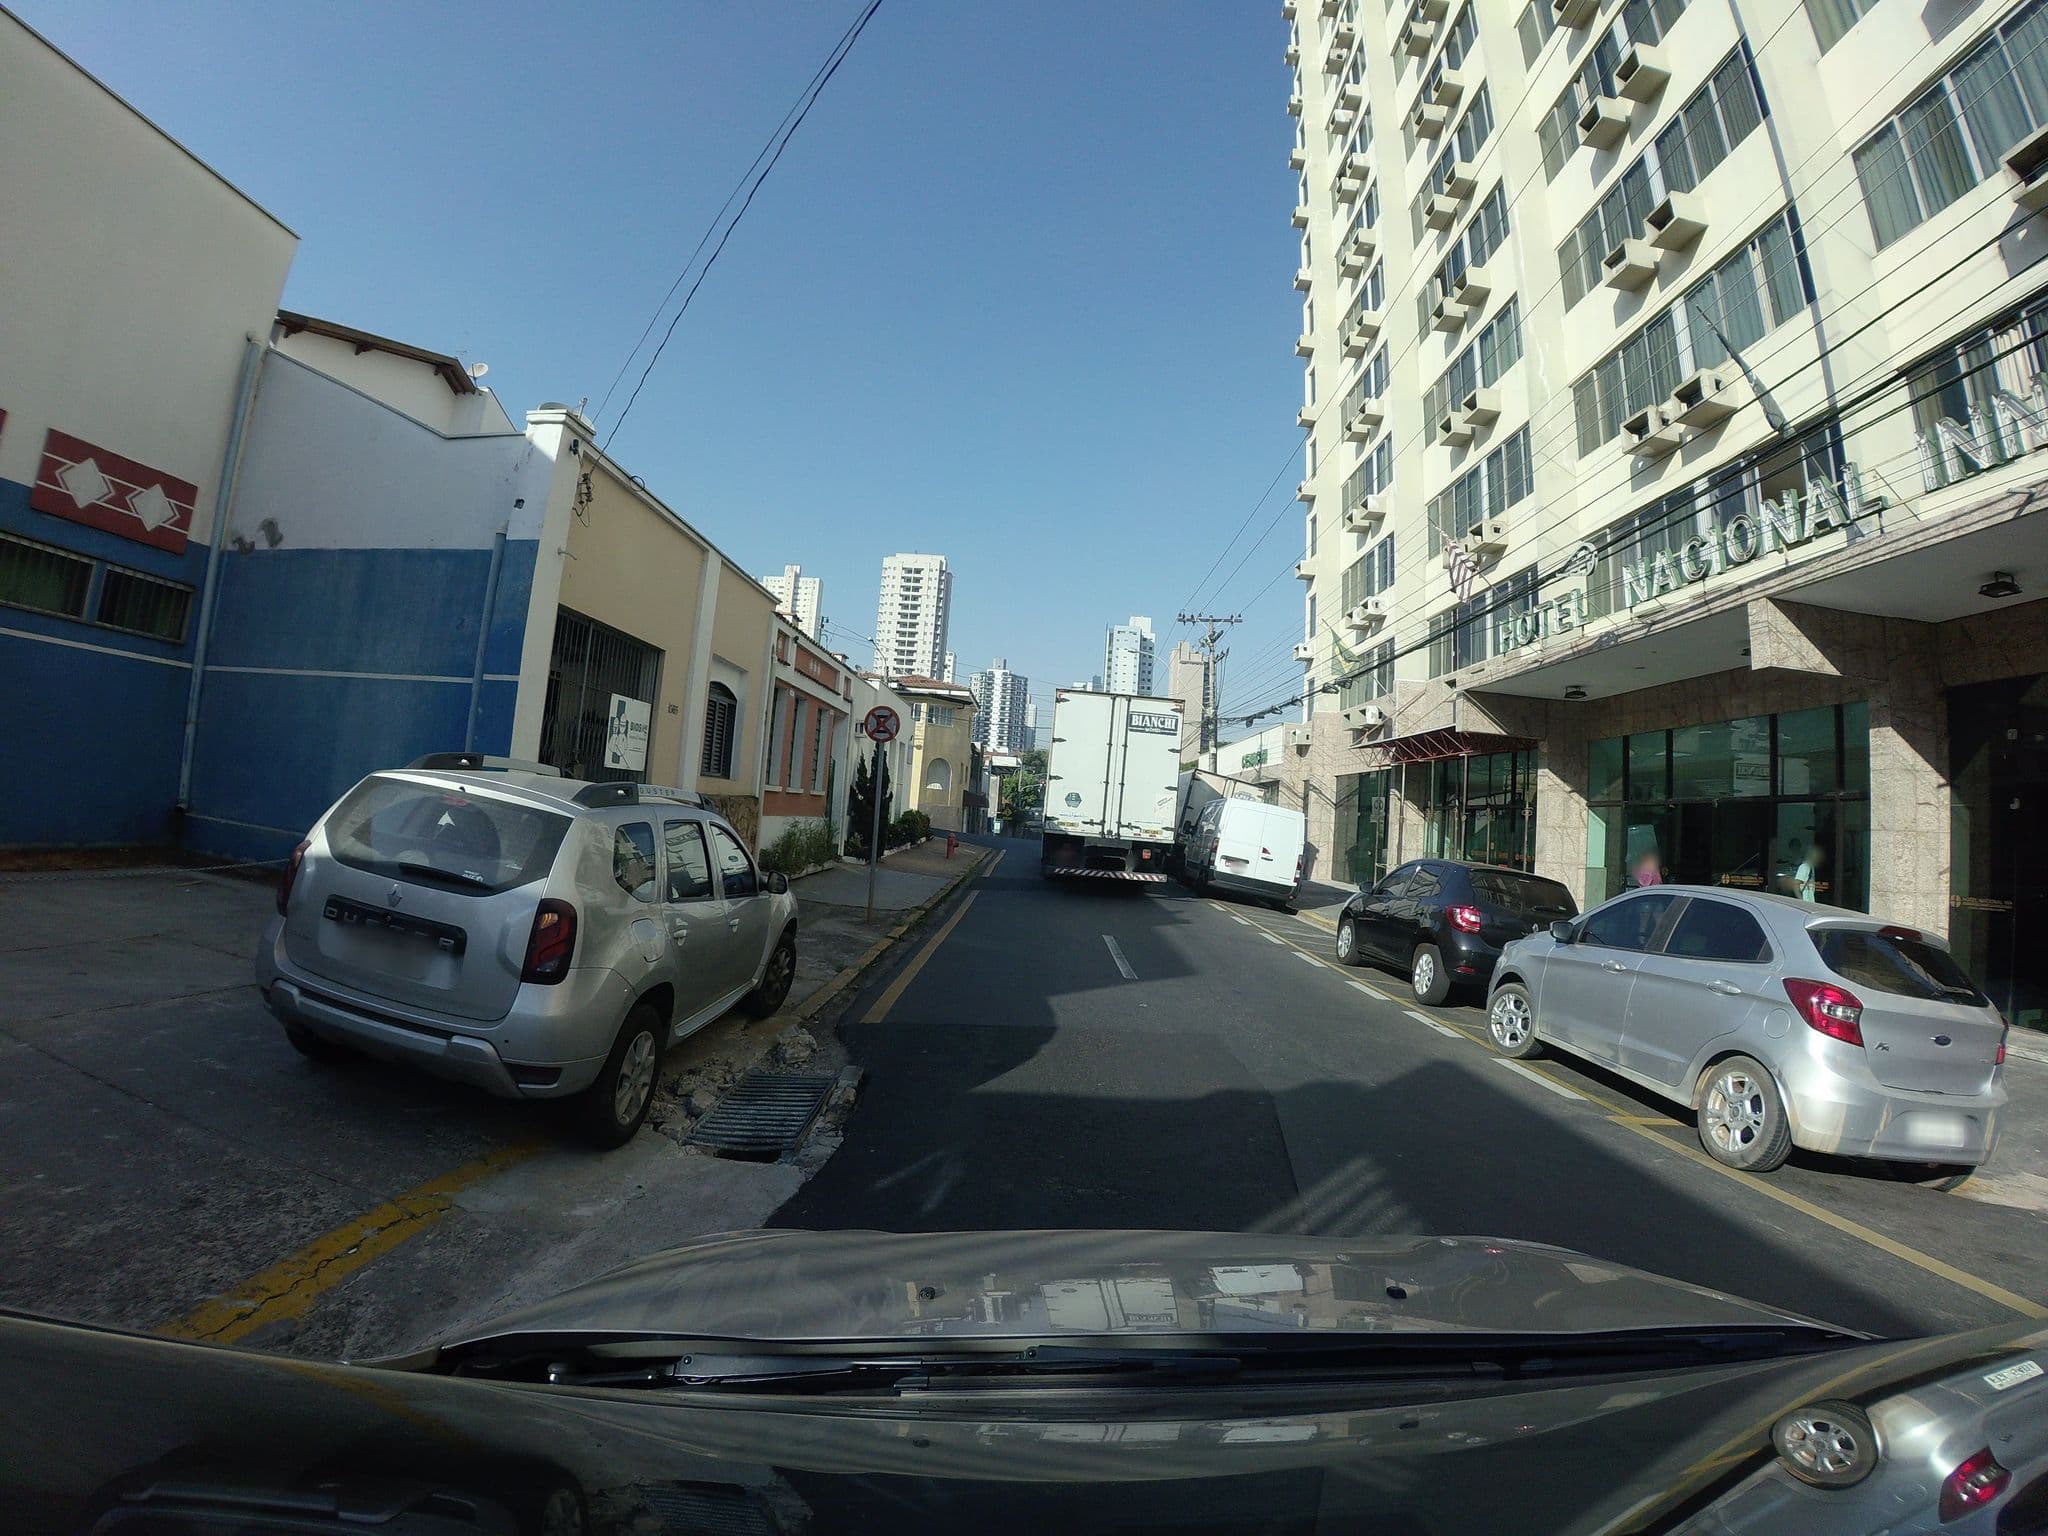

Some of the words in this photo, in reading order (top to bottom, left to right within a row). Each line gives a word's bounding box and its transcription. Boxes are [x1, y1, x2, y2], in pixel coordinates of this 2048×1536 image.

[1497, 588, 1593, 653] HOTEL
[1622, 461, 1889, 608] NACIONAL
[1131, 714, 1176, 729] BIANCHI
[639, 787, 675, 796] DUSTER
